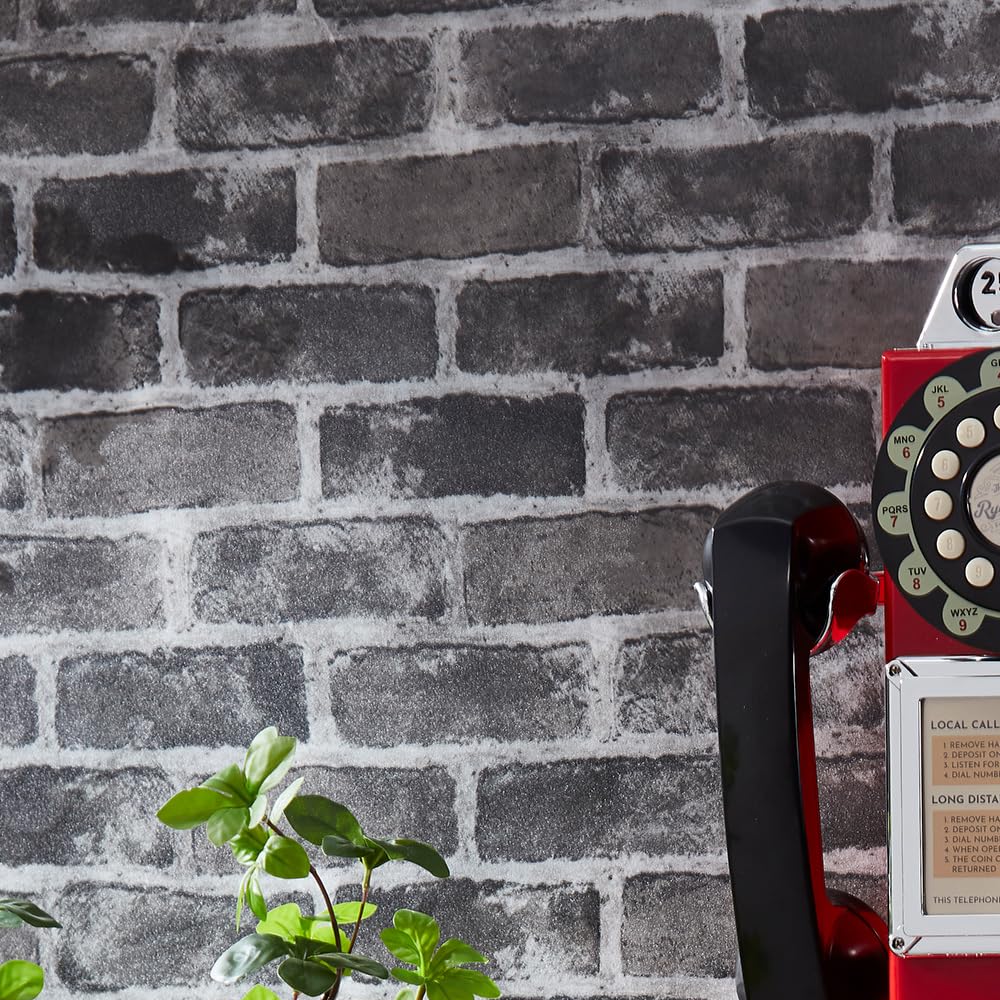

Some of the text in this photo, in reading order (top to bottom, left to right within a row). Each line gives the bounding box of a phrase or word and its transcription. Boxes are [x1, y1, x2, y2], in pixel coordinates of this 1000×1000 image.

[932, 384, 949, 394] JKL
[937, 396, 945, 408] 5
[894, 434, 916, 444] MNO
[902, 446, 910, 459] 6
[882, 505, 908, 515] PQRS
[890, 515, 898, 528] 7
[908, 567, 927, 576] TUV
[913, 578, 920, 590] 8
[950, 608, 978, 617] WXYZ
[960, 619, 967, 631] 9
[931, 720, 1000, 729] LOCAL CALL
[932, 795, 964, 804] LONG
